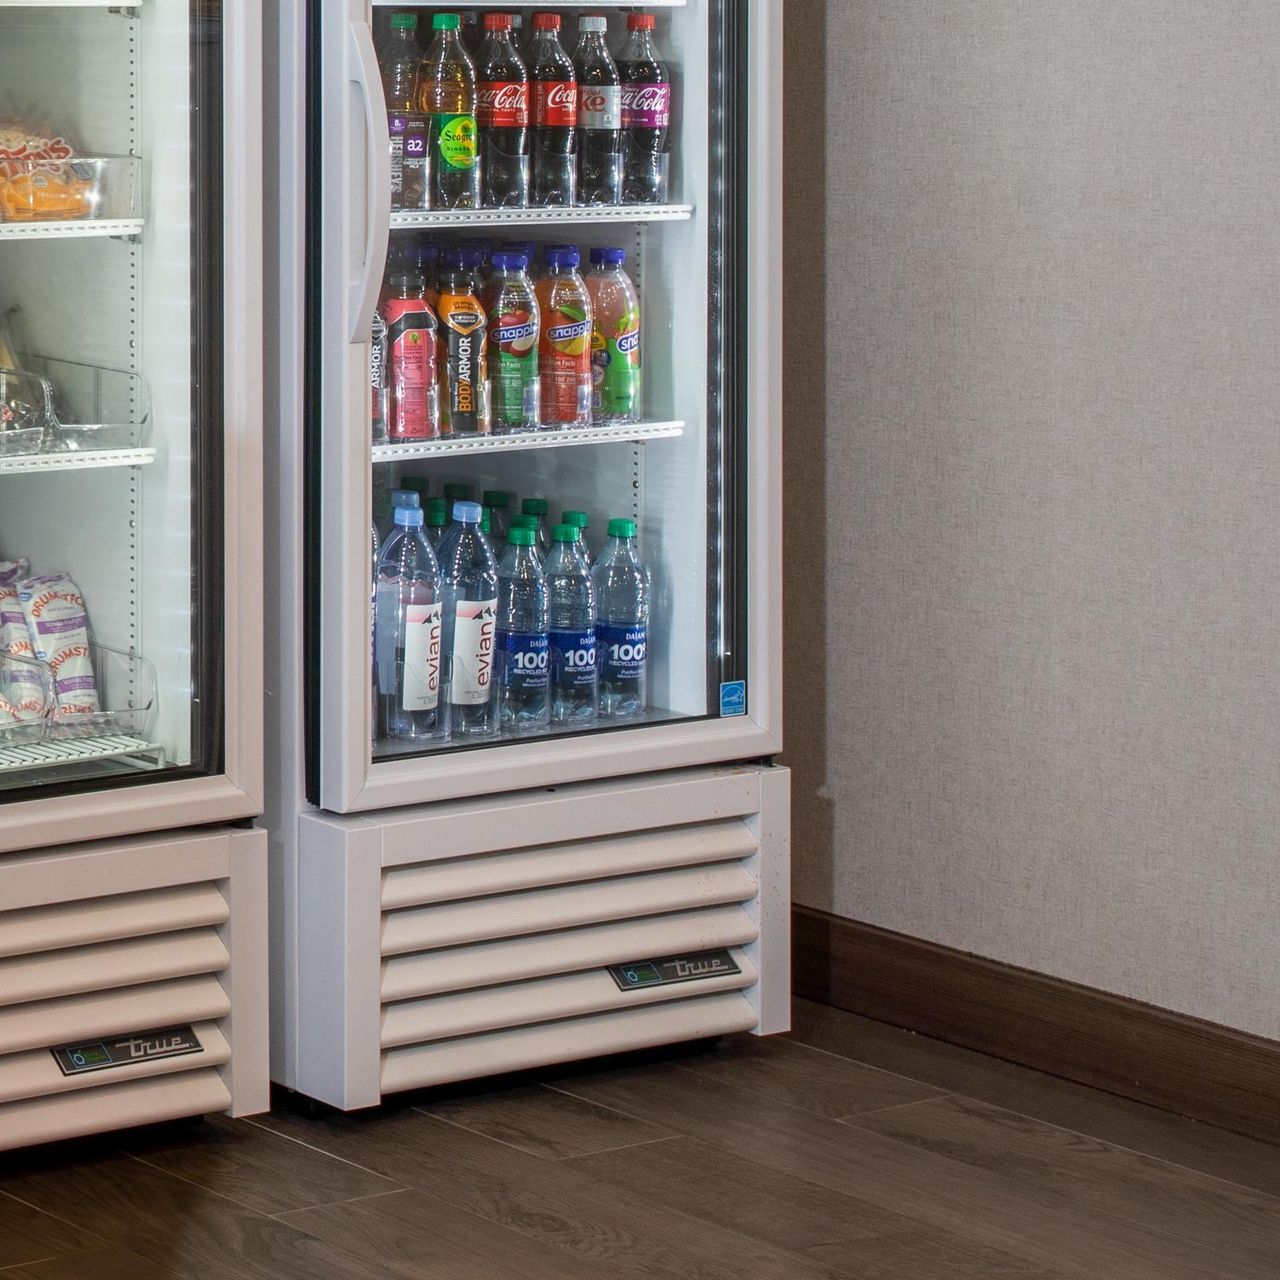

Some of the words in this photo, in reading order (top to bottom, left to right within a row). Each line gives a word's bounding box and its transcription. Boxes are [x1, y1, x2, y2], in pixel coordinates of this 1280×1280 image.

[407, 139, 424, 151] a2
[458, 336, 473, 413] BODYARMOR
[427, 625, 441, 692] evian
[477, 621, 491, 688] evian
[661, 955, 730, 981] true
[115, 1031, 184, 1060] true
